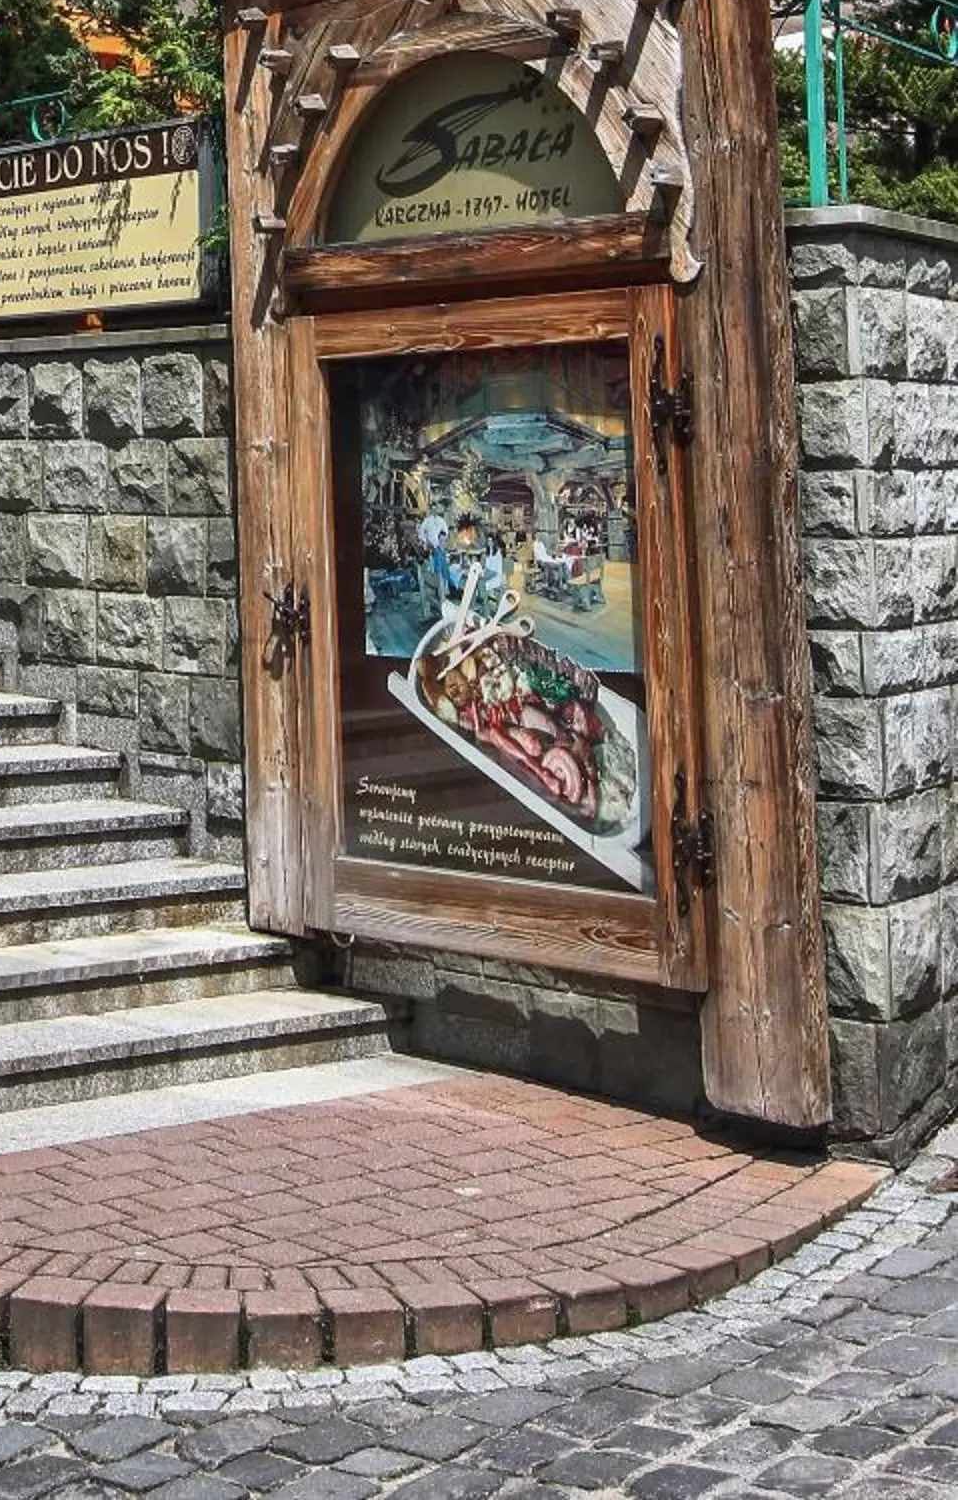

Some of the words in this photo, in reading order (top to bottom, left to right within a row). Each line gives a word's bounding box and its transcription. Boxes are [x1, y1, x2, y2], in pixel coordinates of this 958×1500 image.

[45, 146, 83, 184] DO
[92, 135, 152, 177] NOS
[374, 199, 450, 228] KARCZMA
[516, 186, 571, 211] HOTEL
[356, 776, 417, 804] Serwujemy
[417, 814, 464, 836] potrawy
[358, 828, 396, 852] według
[447, 843, 521, 868] tradycyjnych
[525, 856, 576, 875] receptur
